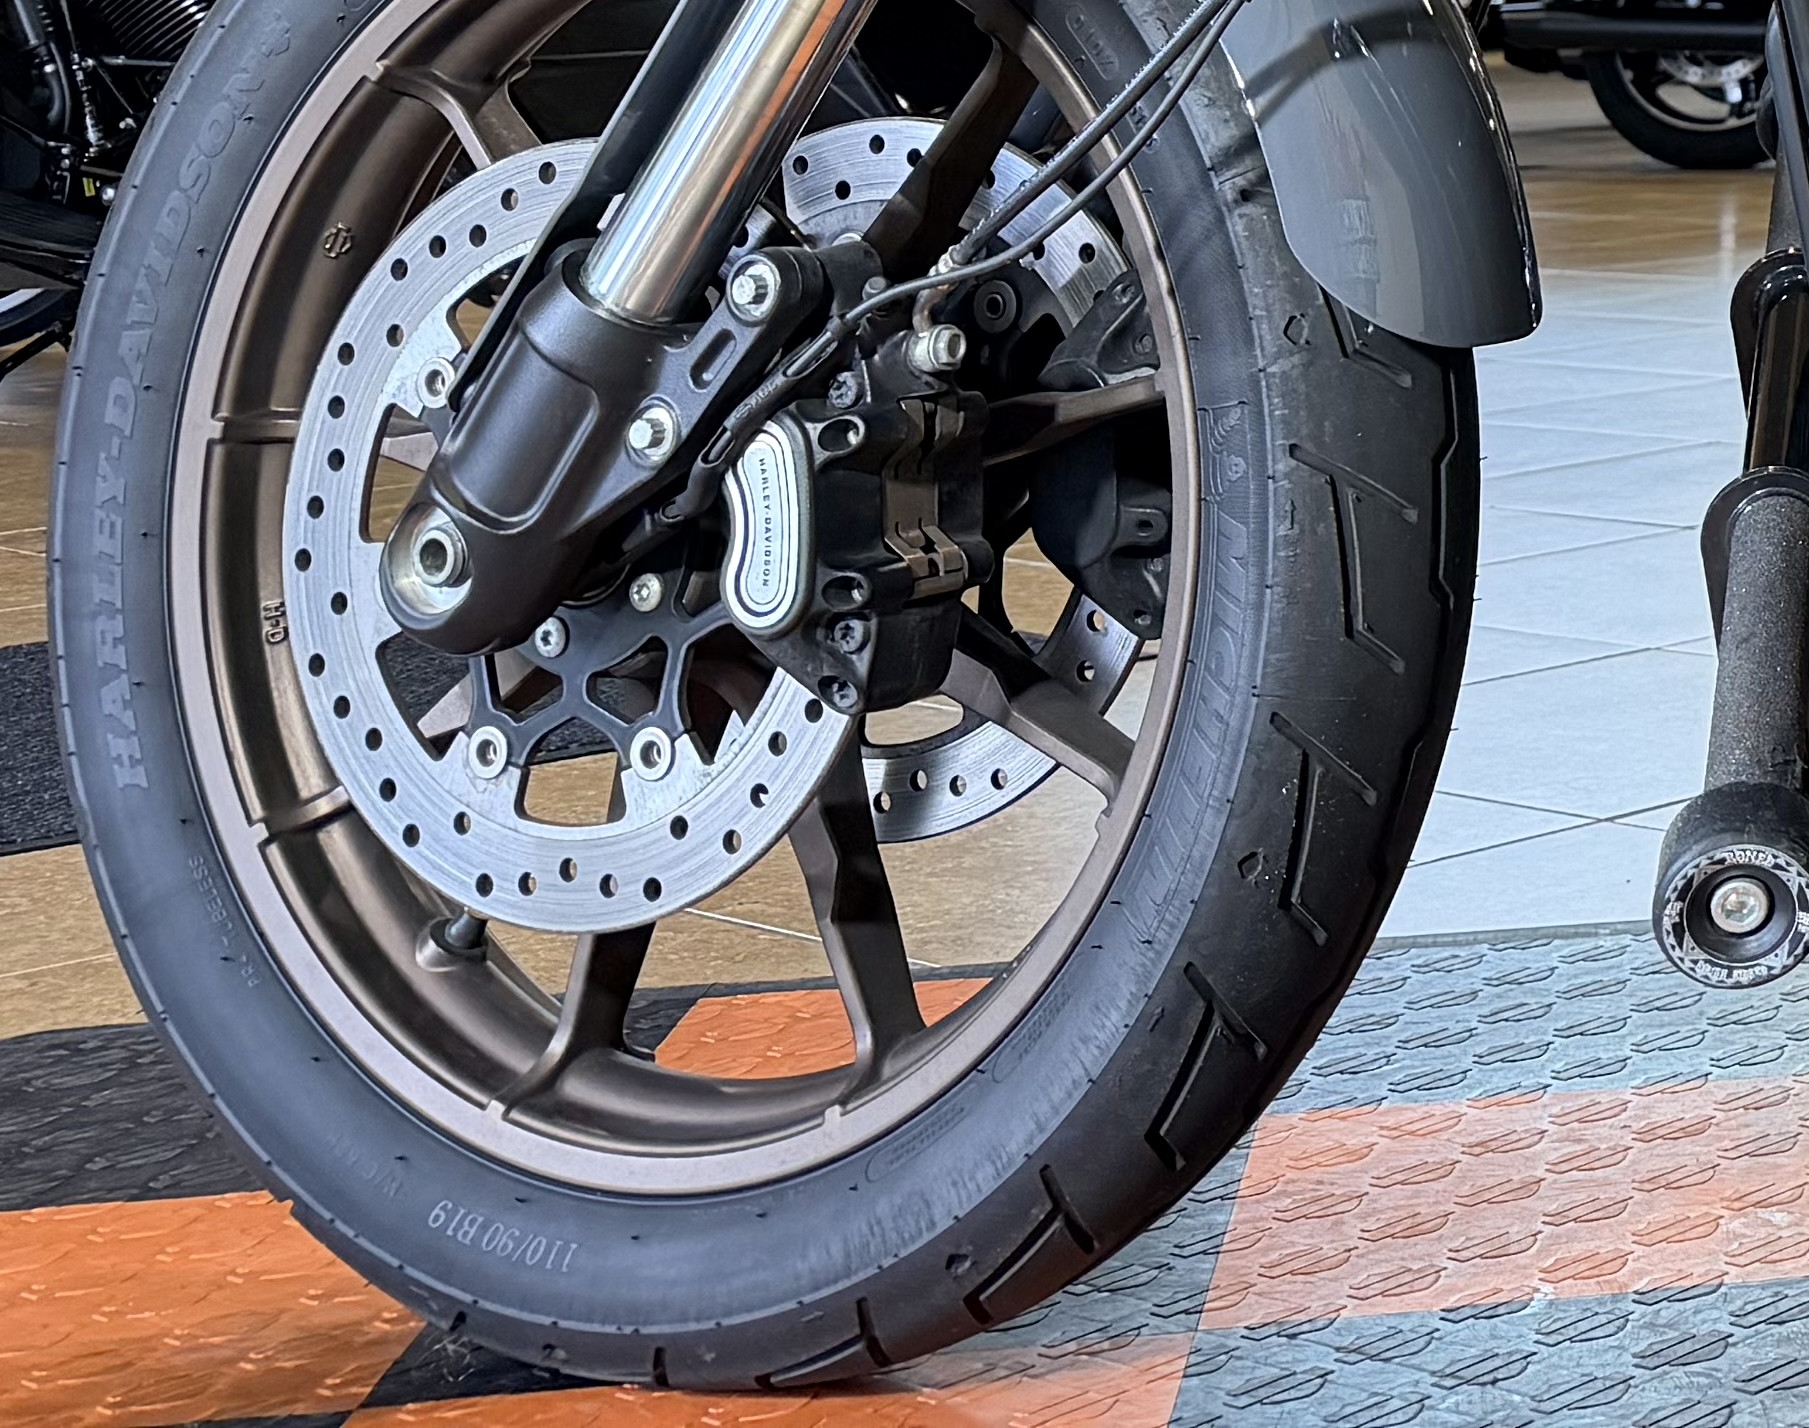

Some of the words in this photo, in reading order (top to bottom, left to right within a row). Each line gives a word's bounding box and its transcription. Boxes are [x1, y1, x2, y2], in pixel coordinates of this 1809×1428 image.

[757, 457, 773, 588] HARLEY-DAVIDSON
[426, 1198, 485, 1247] B19
[480, 1221, 579, 1273] 110/90
